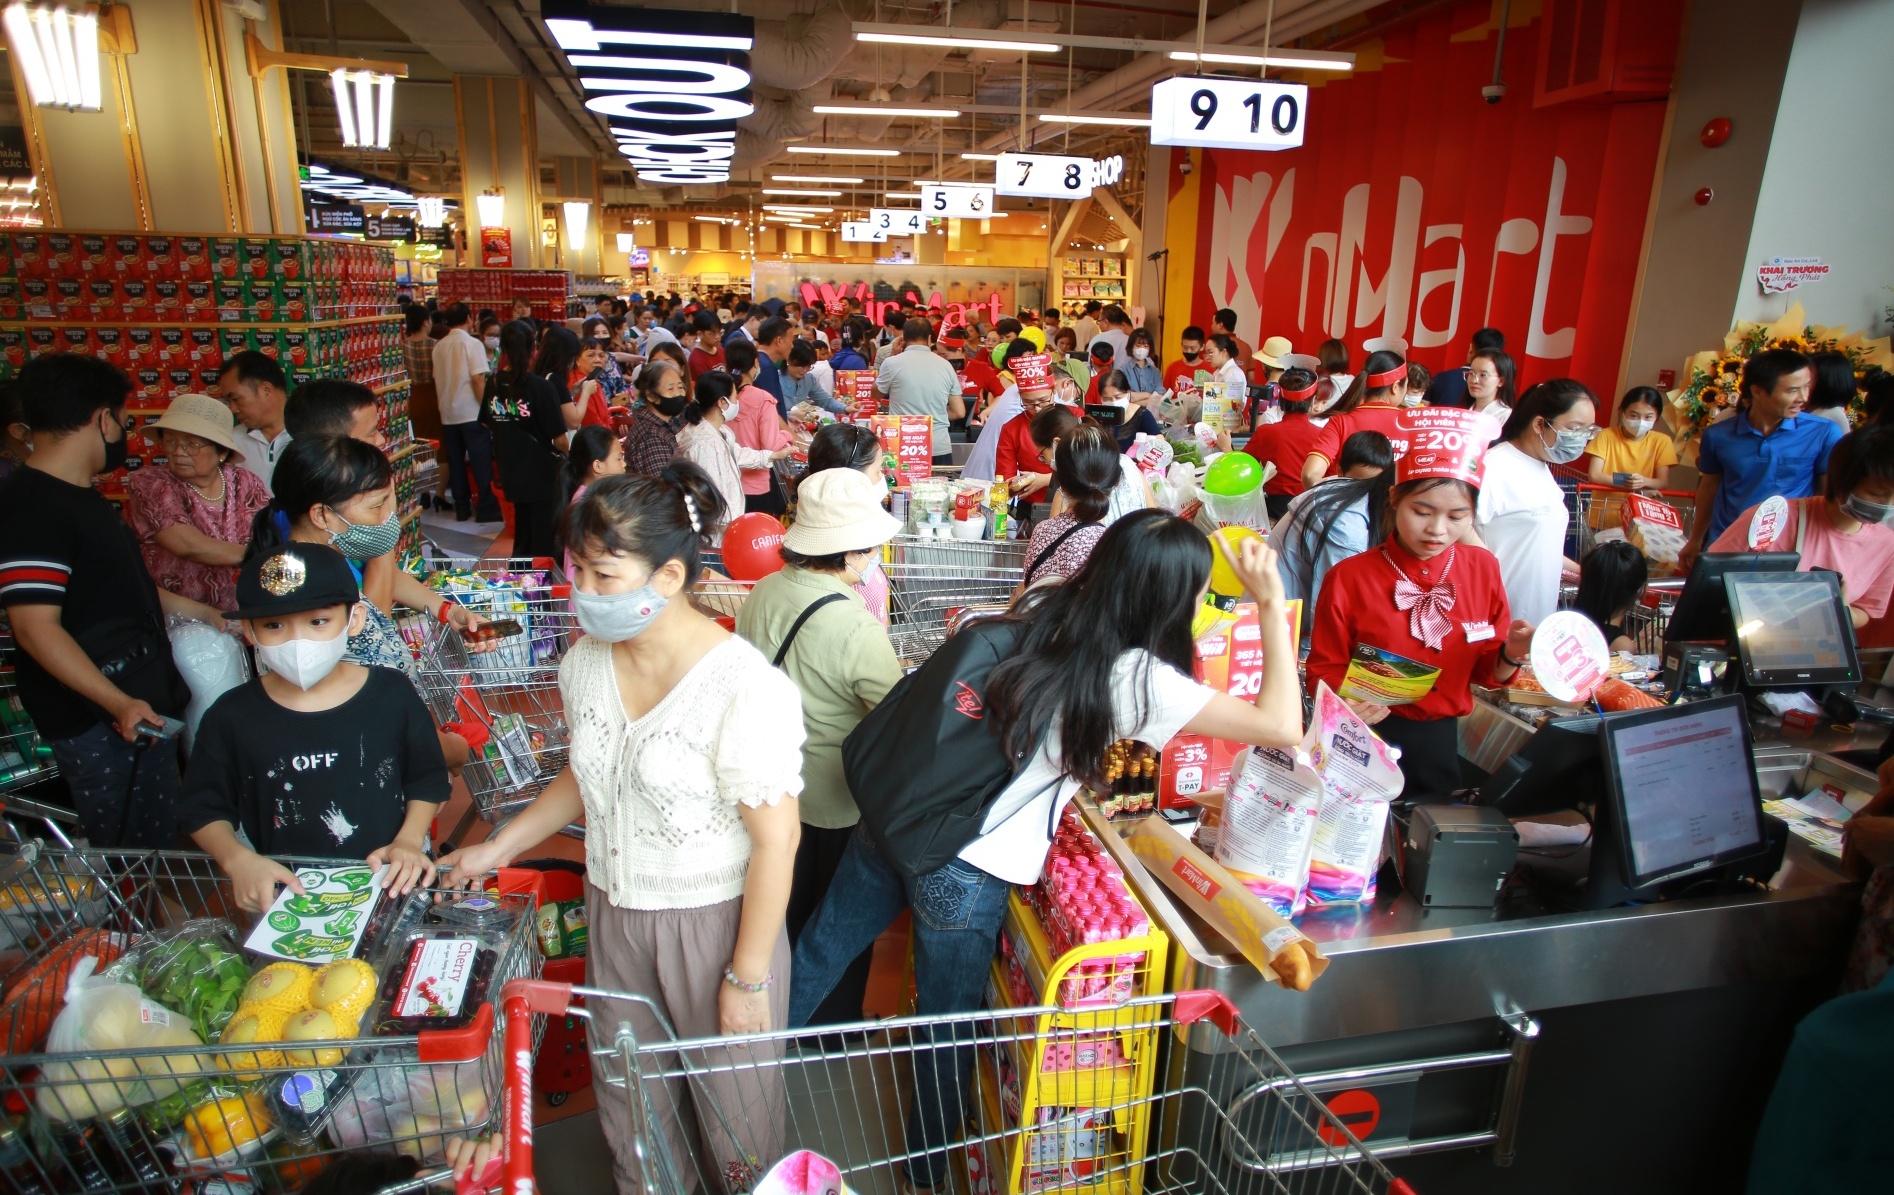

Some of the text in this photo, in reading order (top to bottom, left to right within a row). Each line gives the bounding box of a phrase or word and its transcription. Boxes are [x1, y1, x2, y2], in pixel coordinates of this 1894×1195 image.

[1190, 89, 1299, 136] 9 10
[1016, 161, 1081, 190] 7 8
[933, 192, 984, 212] 5 6
[368, 220, 381, 237] 5
[880, 213, 920, 230] 3 4
[849, 226, 856, 238] 1
[1760, 265, 1829, 274] KHAI TRƯƠNG
[1407, 409, 1421, 417] ƯU
[1422, 408, 1439, 416] ĐÃI
[1440, 409, 1460, 419] ĐẶC
[1414, 418, 1431, 428] HỘI
[900, 445, 928, 456] 20%
[1427, 431, 1481, 456] 20%
[1236, 651, 1255, 660] 365
[1340, 722, 1367, 744] Comfort
[292, 752, 338, 771] OFF
[1185, 748, 1207, 762] 3%
[1179, 783, 1199, 791] T-PAY
[1180, 865, 1211, 895] WinMart
[448, 942, 473, 982] Cherry
